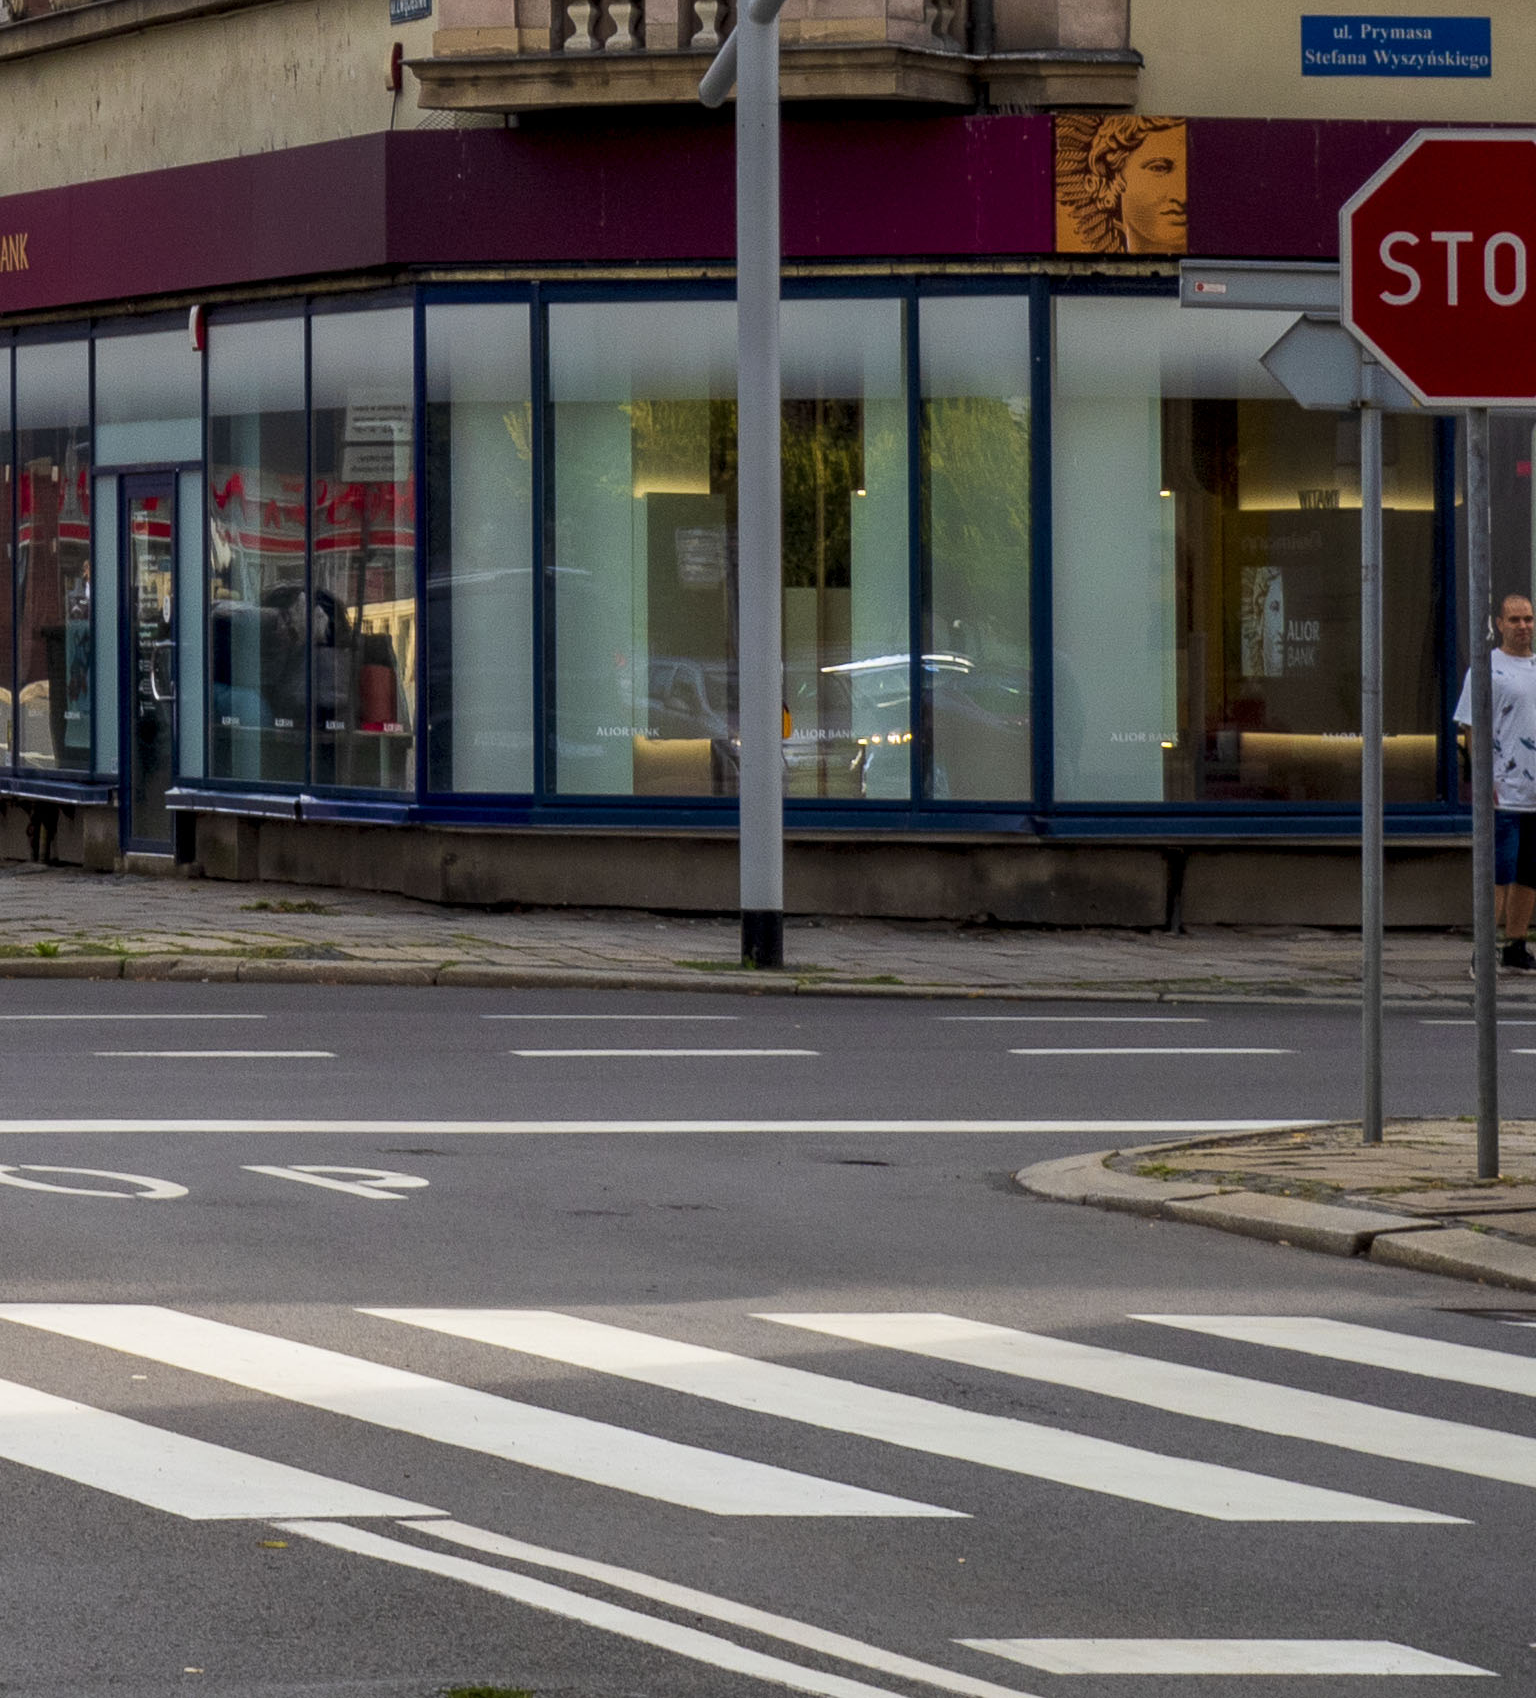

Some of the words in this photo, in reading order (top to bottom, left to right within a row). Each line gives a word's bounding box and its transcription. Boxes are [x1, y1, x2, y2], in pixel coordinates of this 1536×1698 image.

[1333, 24, 1353, 40] ul.
[1360, 23, 1432, 44] Prymasa
[1304, 48, 1367, 66] Stefana
[1372, 49, 1489, 70] Wyszyńskiego
[1379, 230, 1527, 307] STO
[1287, 619, 1321, 642] ALIOR
[1287, 645, 1316, 667] BANK
[596, 726, 629, 737] ALIOR
[630, 726, 660, 737] BANK
[792, 729, 826, 740] ALIOR
[1110, 732, 1147, 743] ALIOR
